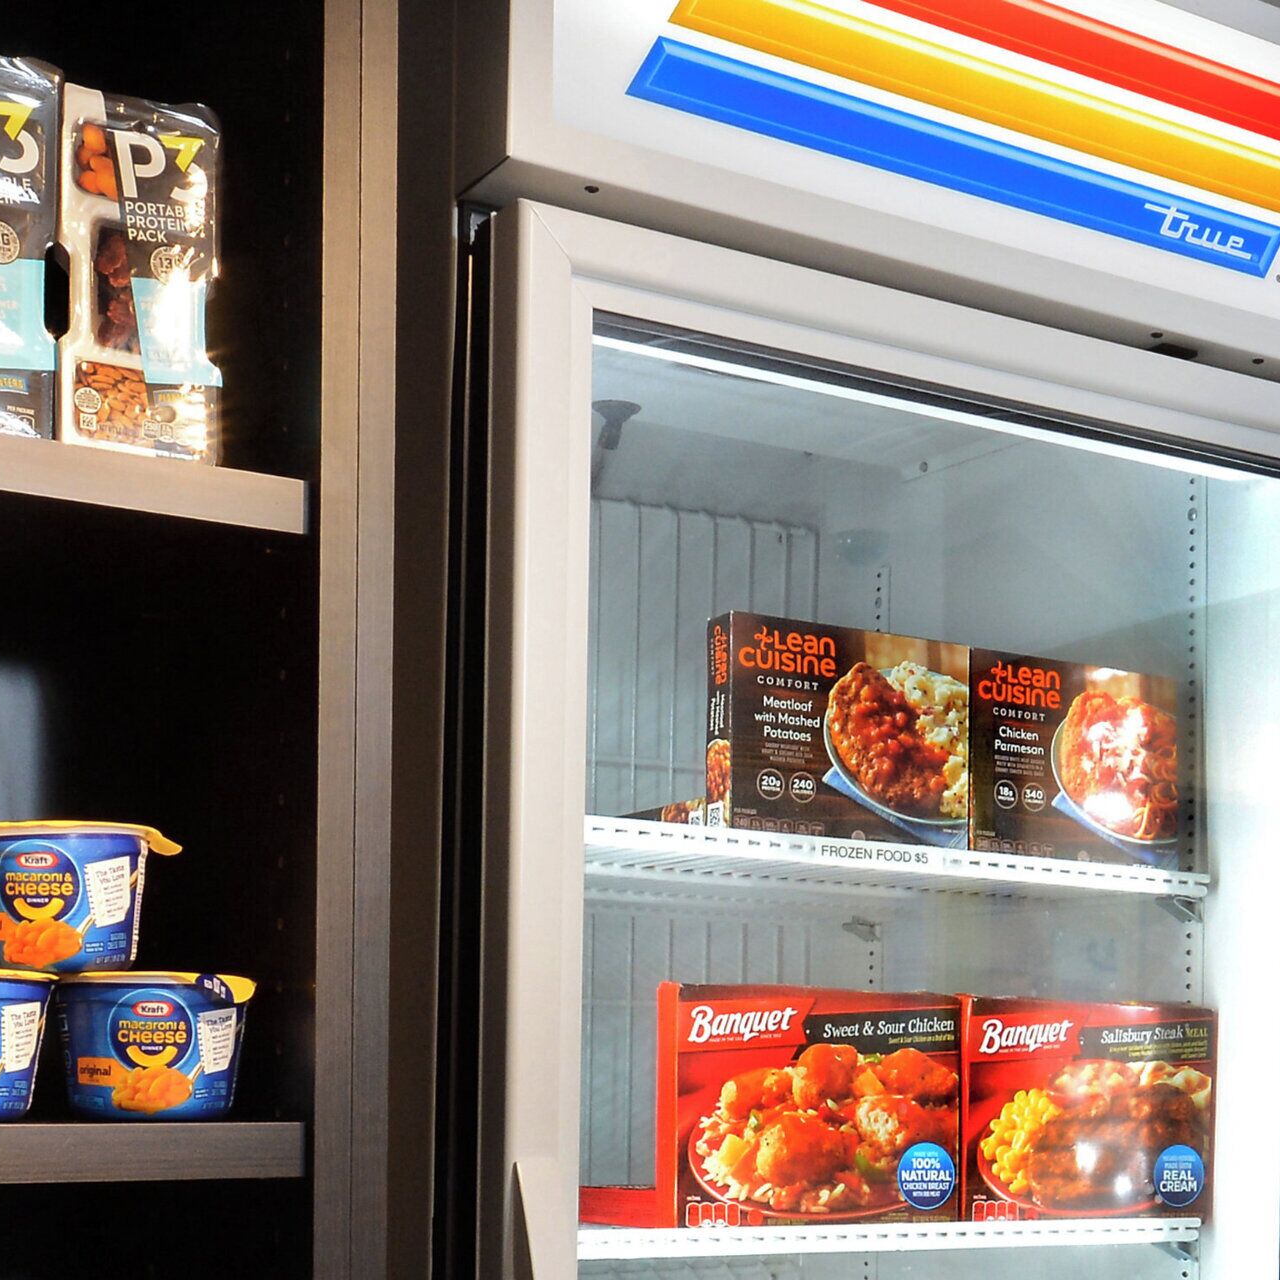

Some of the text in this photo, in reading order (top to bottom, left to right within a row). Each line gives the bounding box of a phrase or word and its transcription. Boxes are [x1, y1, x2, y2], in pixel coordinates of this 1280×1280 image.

[127, 229, 168, 243] PACK
[757, 675, 819, 691] COMFORT
[763, 695, 813, 712] Meatloaf
[754, 711, 820, 729] with Mashed
[993, 707, 1046, 722] COMFORT
[763, 727, 812, 742] Potatoes
[998, 726, 1039, 741] Chicken
[994, 739, 1045, 756] Parmesan
[792, 778, 814, 790] 240
[1024, 787, 1044, 799] 340
[24, 855, 49, 866] Kraft
[821, 845, 929, 867] FROZEN FOOD $5
[5, 871, 63, 883] macaroni
[140, 1004, 164, 1014] Kraft
[118, 1019, 178, 1031] macaroni
[687, 1004, 798, 1043] Banquet
[823, 1016, 955, 1038] Sweet Sour Chicken
[978, 1018, 1074, 1054] Banquet
[1100, 1025, 1184, 1045] Salisbury Steak
[911, 1157, 941, 1170] 100%
[901, 1169, 952, 1182] NATURAL
[1163, 1170, 1195, 1181] REAL
[1159, 1180, 1198, 1193] CREAM
